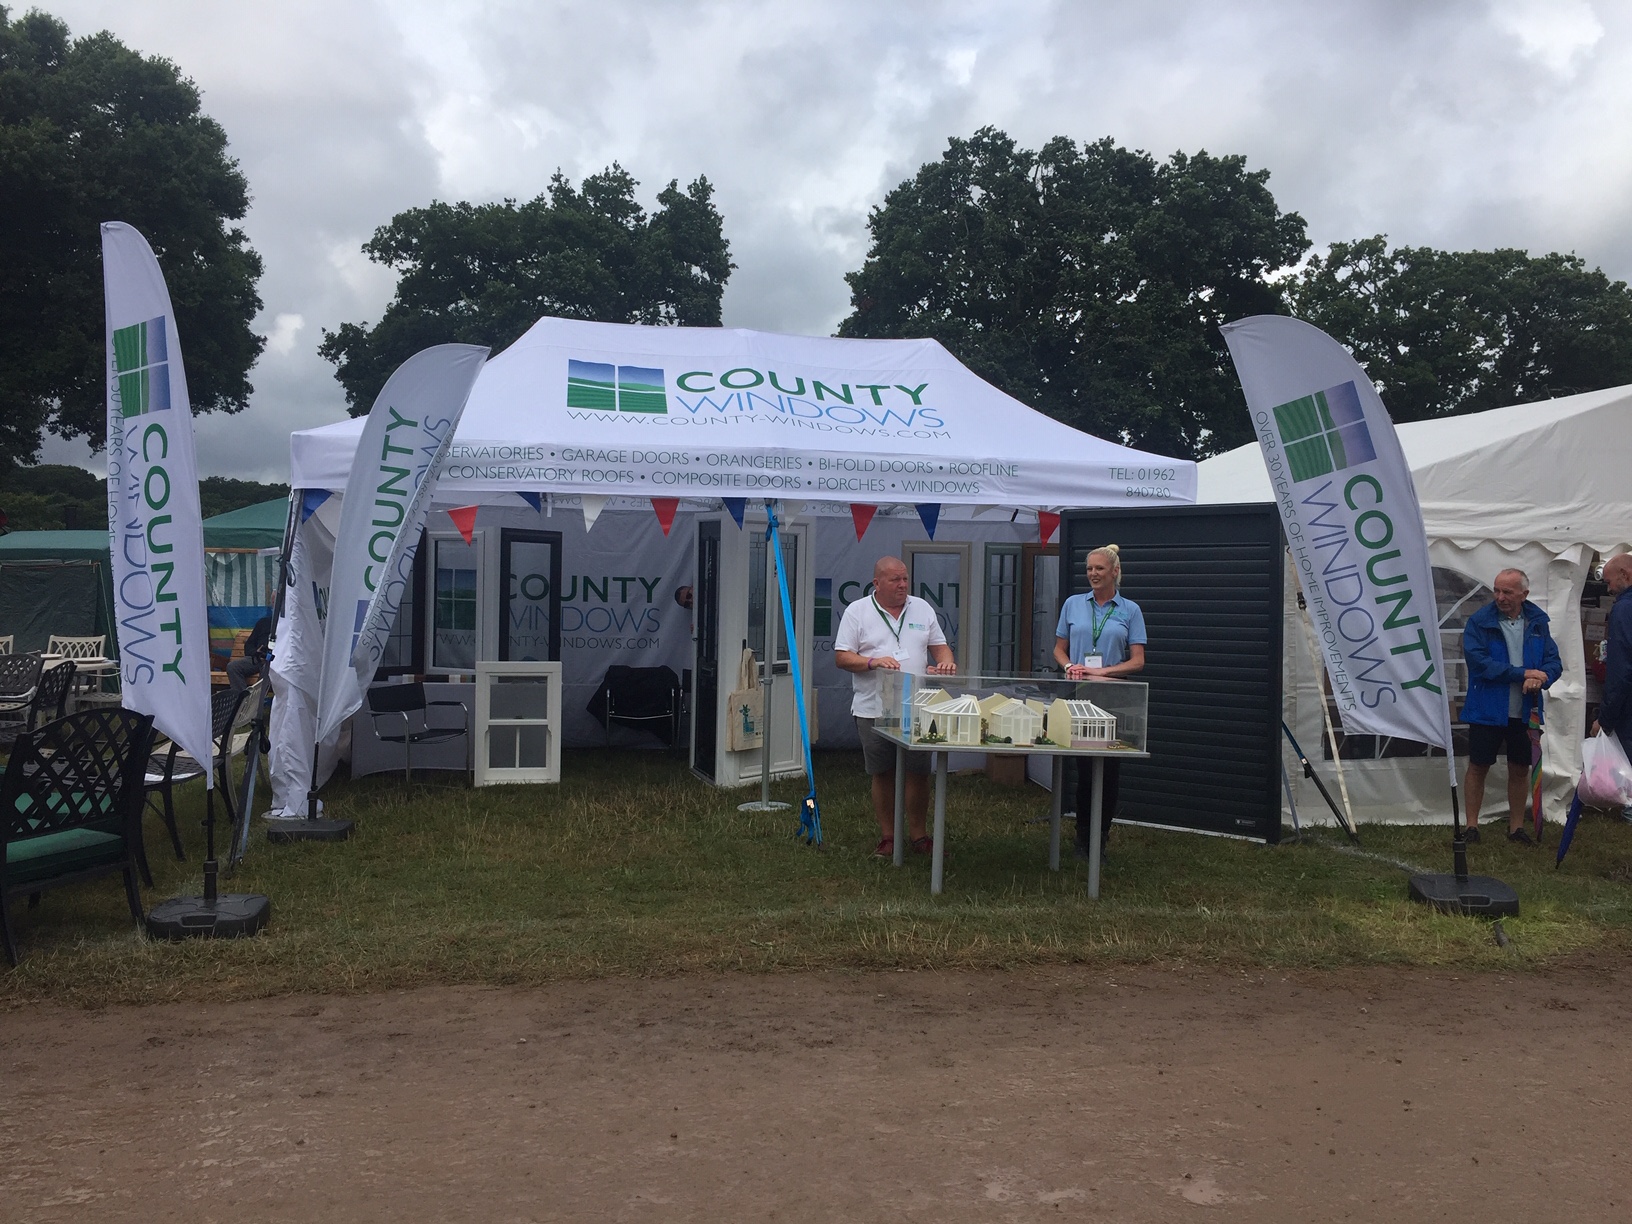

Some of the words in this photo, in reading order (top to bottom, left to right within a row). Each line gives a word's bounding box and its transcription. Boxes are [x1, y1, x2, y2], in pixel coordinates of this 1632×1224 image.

[676, 367, 929, 406] COUNTY
[566, 410, 951, 440] WWW.COUNTY-WINDOWS.COM
[675, 391, 944, 428] WINDOWS
[1256, 411, 1277, 453] OVER
[445, 446, 544, 461] ERVATORIES
[562, 449, 627, 463] GARAGE
[633, 451, 690, 465] DOORS
[706, 453, 803, 470] ORANGERIES
[819, 458, 876, 471] BI-FOLD
[880, 460, 934, 474] DOORS
[949, 462, 1019, 477] ROOFLINE
[448, 465, 577, 481] CONSERVATORY
[582, 470, 635, 483] ROOFS
[652, 471, 742, 487] COMPOSITE
[746, 474, 802, 489] DOORS
[818, 477, 886, 492] PORCHES
[901, 480, 980, 494] WINDOWS
[1108, 467, 1135, 481] TEL:
[1137, 468, 1176, 481] 01962
[1126, 486, 1171, 498] 840780
[1275, 471, 1297, 519] YEARS
[1289, 522, 1305, 543] OF
[143, 423, 187, 686] COUNTY
[1296, 545, 1321, 594] HOME
[1301, 480, 1397, 709] WINDOWS
[1343, 474, 1443, 696] COUNTY
[1313, 596, 1357, 711] IMPROVEMENTS
